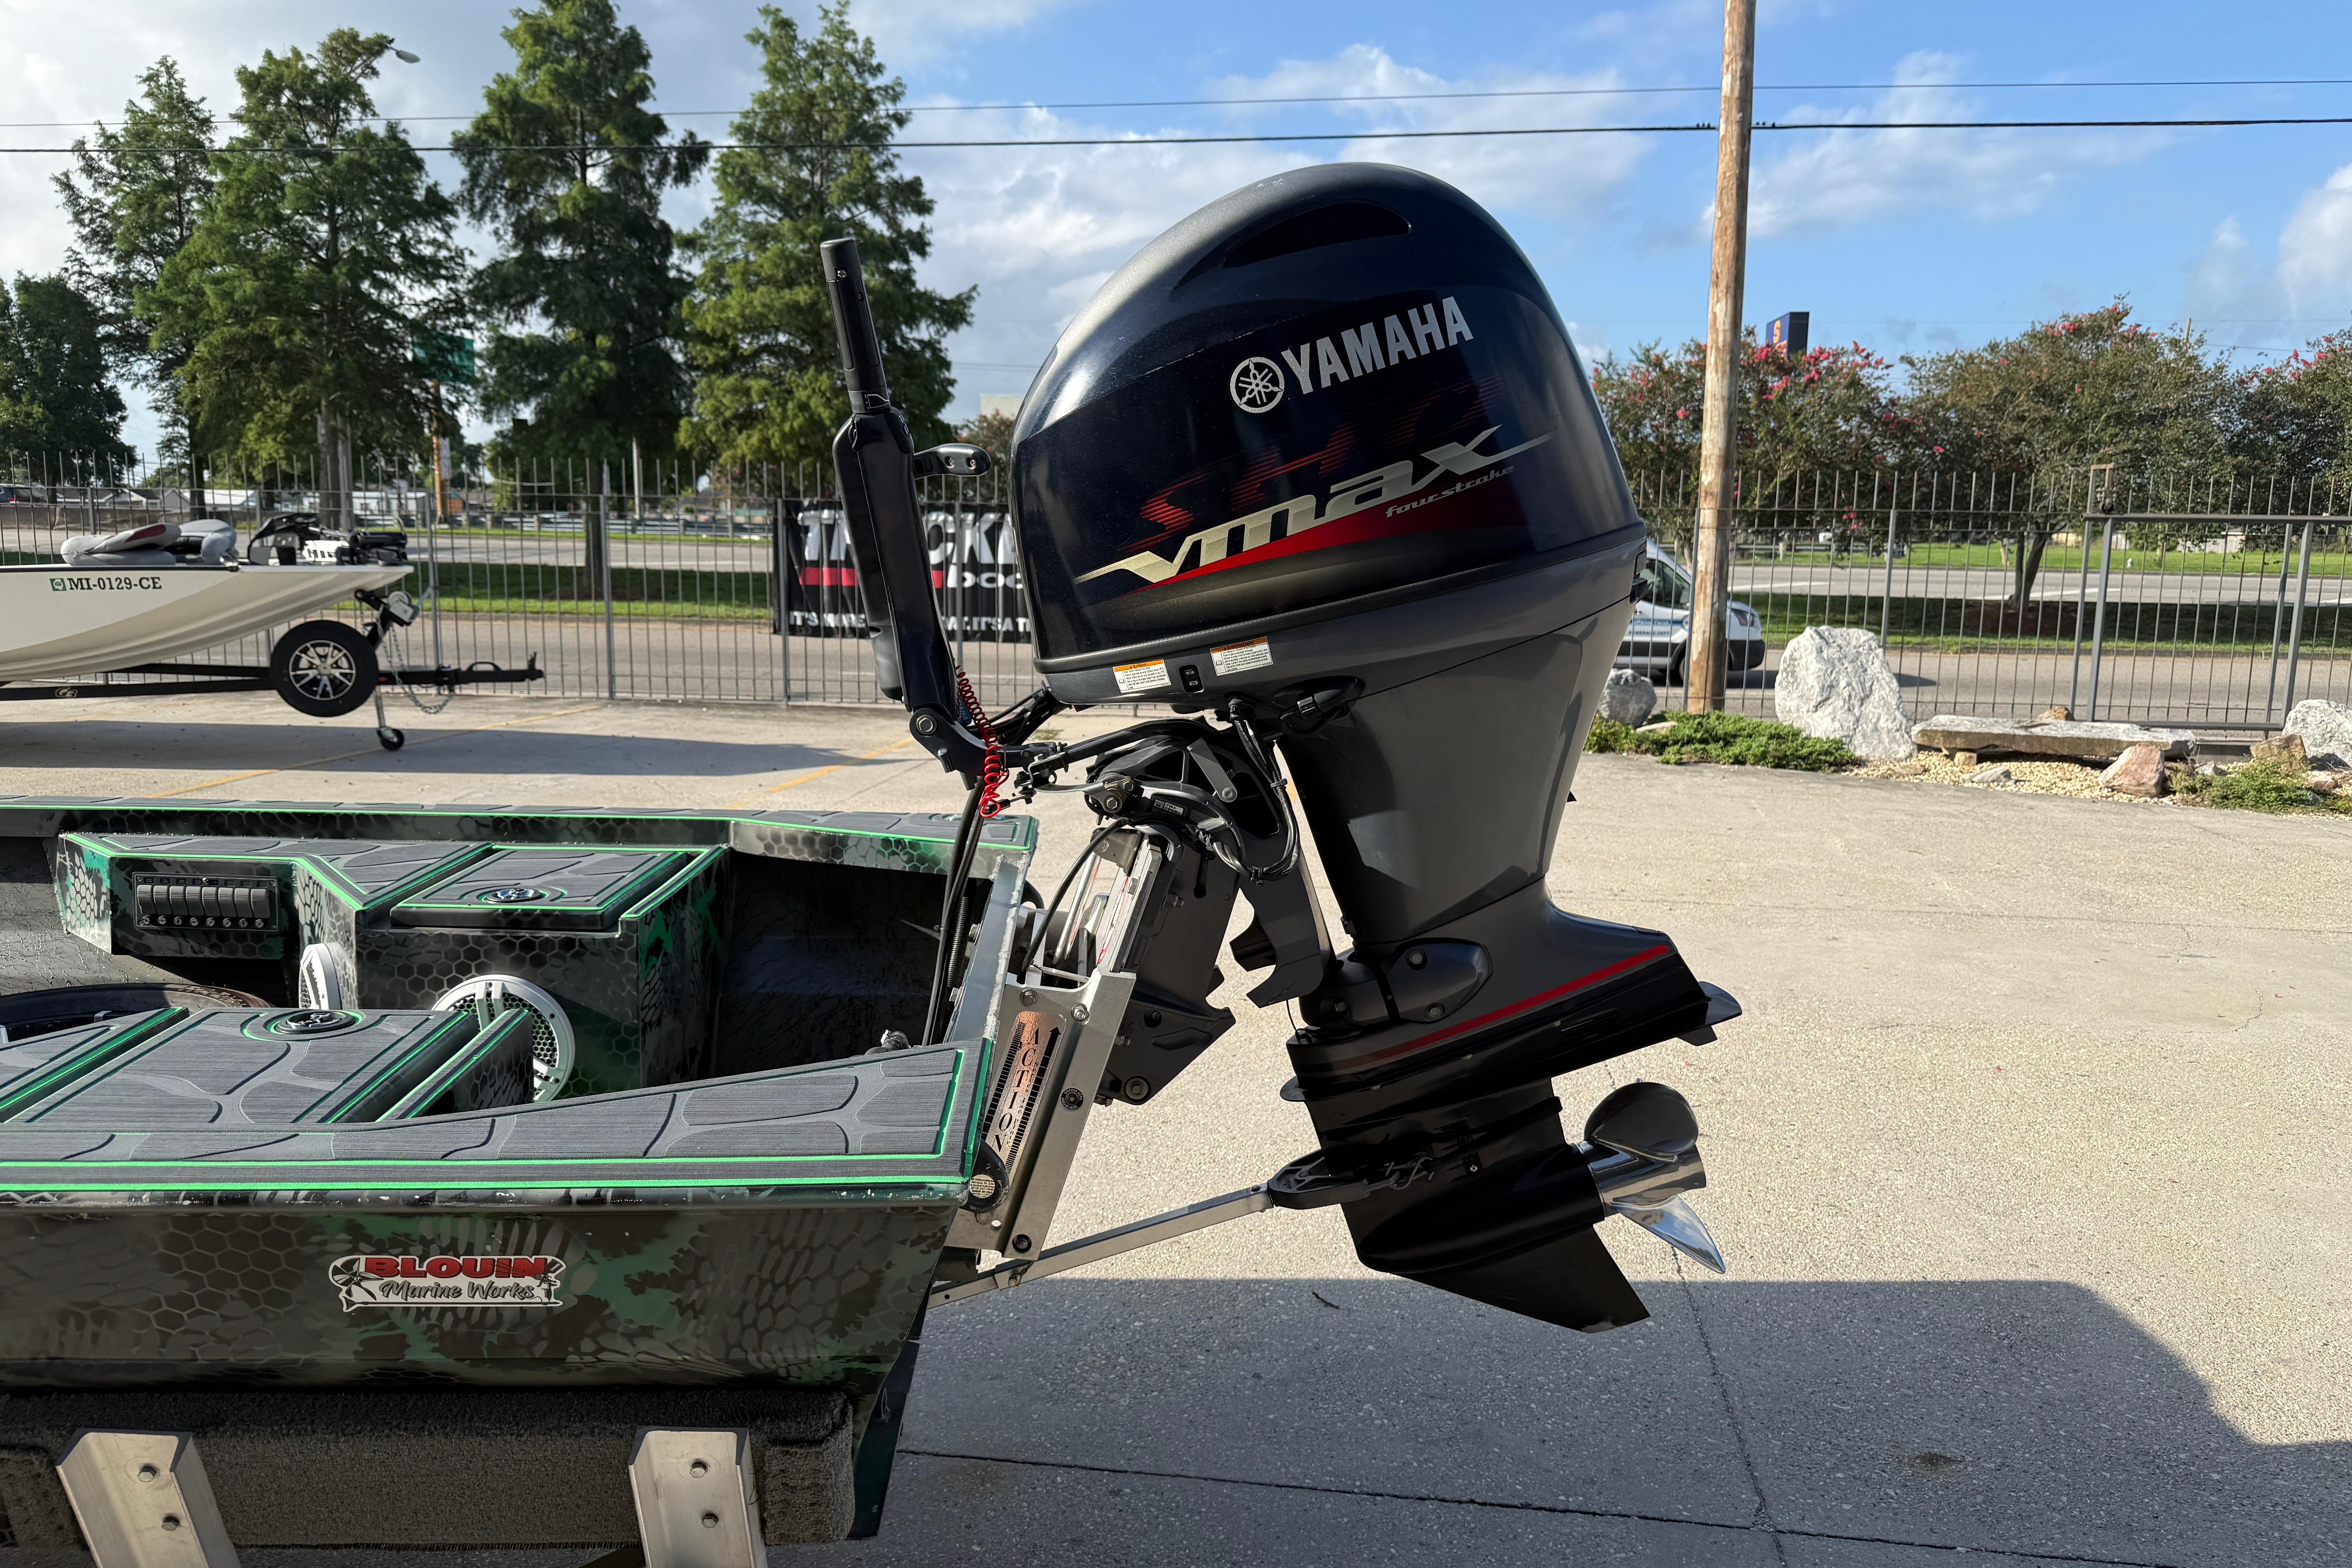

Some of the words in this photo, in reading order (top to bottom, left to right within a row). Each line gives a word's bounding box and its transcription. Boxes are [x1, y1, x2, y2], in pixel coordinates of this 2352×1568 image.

[1281, 296, 1474, 394] YAMAHA
[67, 577, 161, 590] MI-0129-CE
[992, 1027, 1039, 1152] ACTION
[364, 1257, 548, 1278] BLOUIN
[379, 1280, 462, 1301] Marine
[468, 1281, 535, 1300] Works
